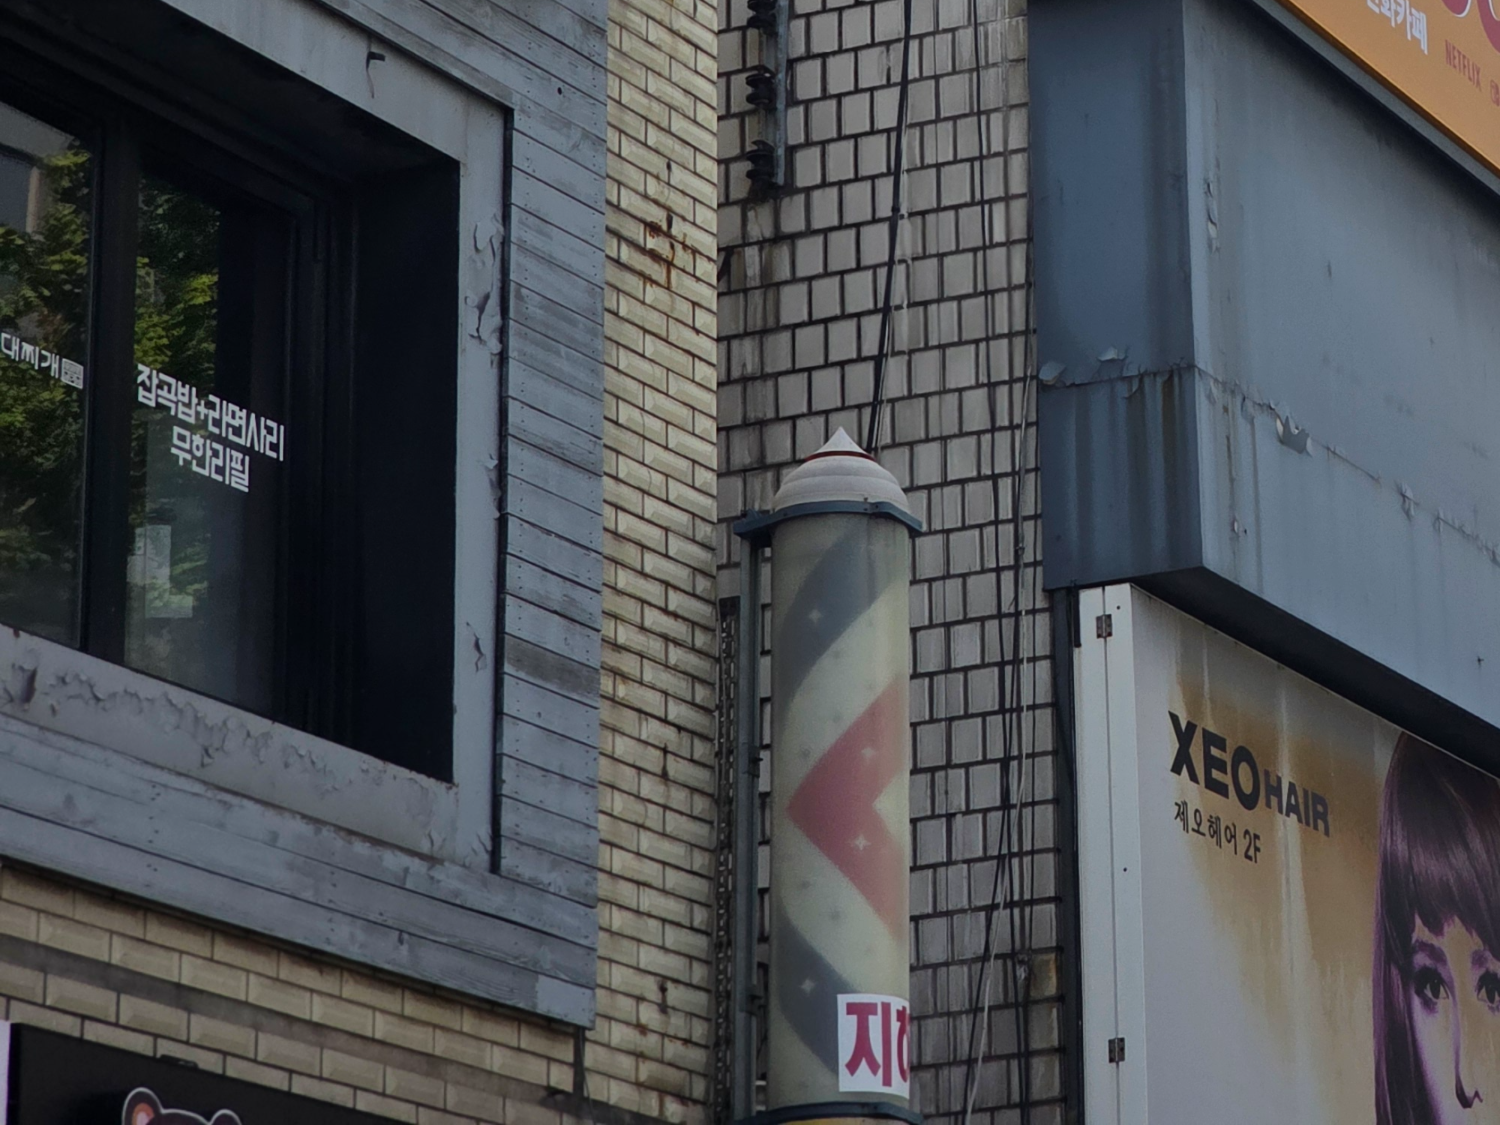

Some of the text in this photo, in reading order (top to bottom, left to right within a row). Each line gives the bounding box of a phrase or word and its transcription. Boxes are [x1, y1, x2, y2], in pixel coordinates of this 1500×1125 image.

[1445, 39, 1482, 93] NETFLIX
[170, 425, 250, 493] 무한리필
[1243, 828, 1261, 864] 2F
